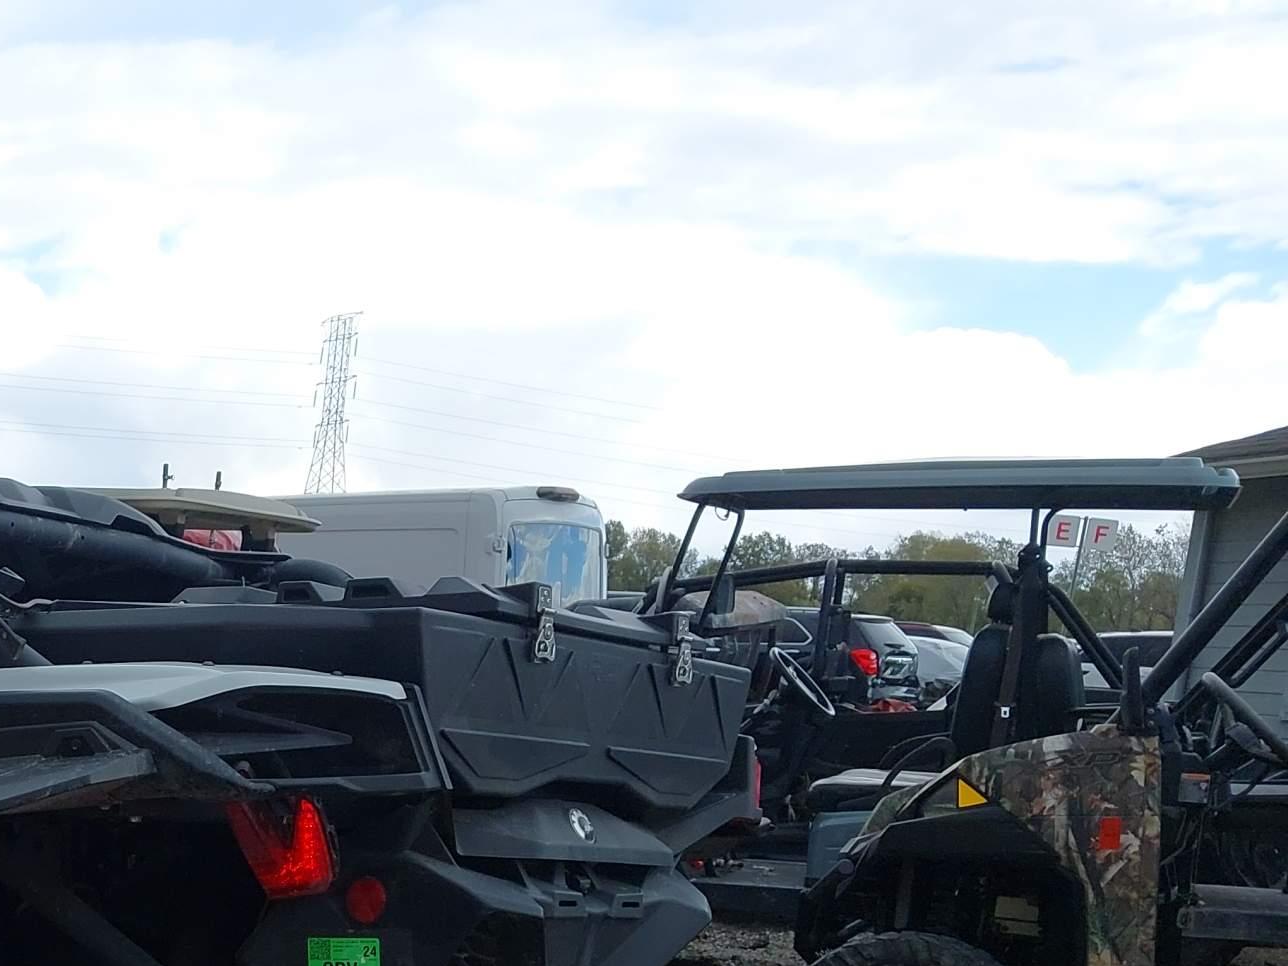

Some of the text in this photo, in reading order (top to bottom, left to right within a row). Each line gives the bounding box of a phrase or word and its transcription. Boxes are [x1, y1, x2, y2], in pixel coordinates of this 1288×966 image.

[1056, 522, 1071, 540] E
[1094, 525, 1109, 543] F
[362, 945, 377, 958] 24
